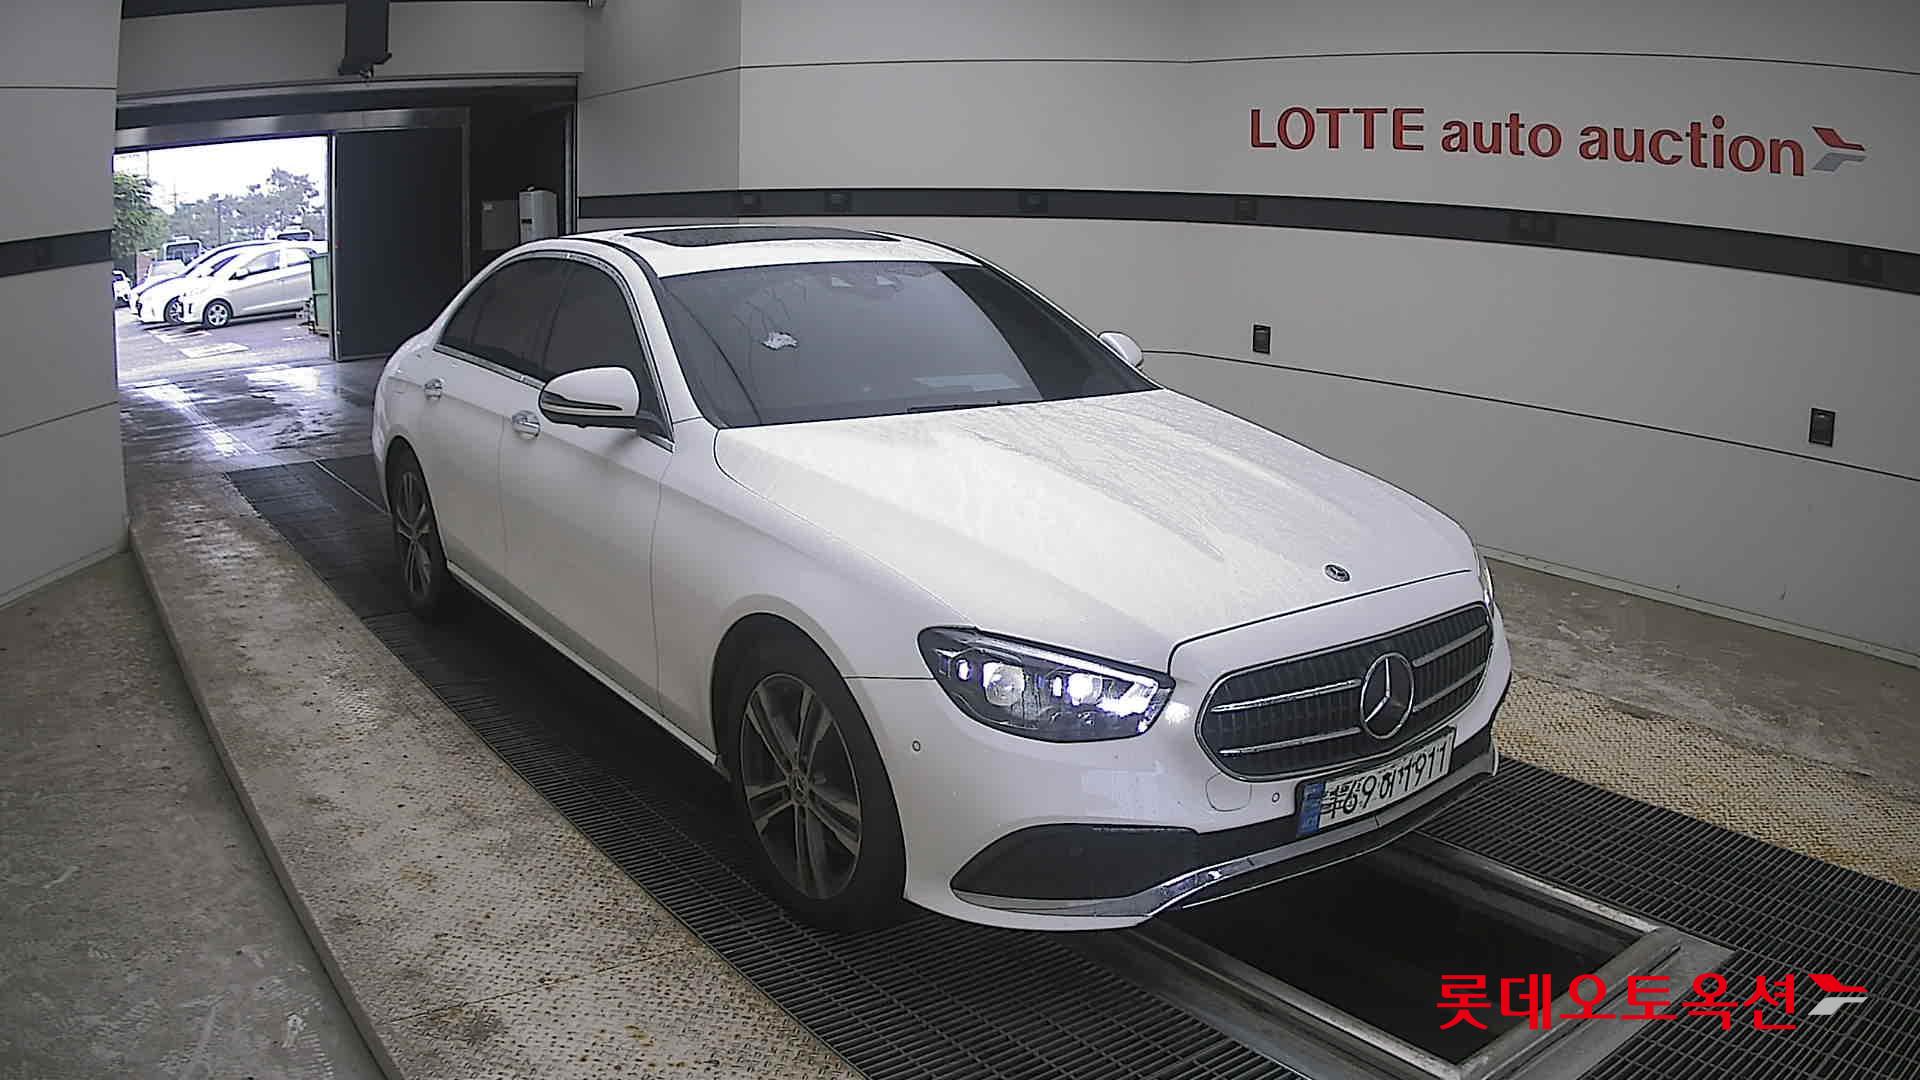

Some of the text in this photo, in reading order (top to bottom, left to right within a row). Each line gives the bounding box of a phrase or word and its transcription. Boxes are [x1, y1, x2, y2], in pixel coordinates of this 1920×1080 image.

[1250, 107, 1805, 176] LOTTE auto auction
